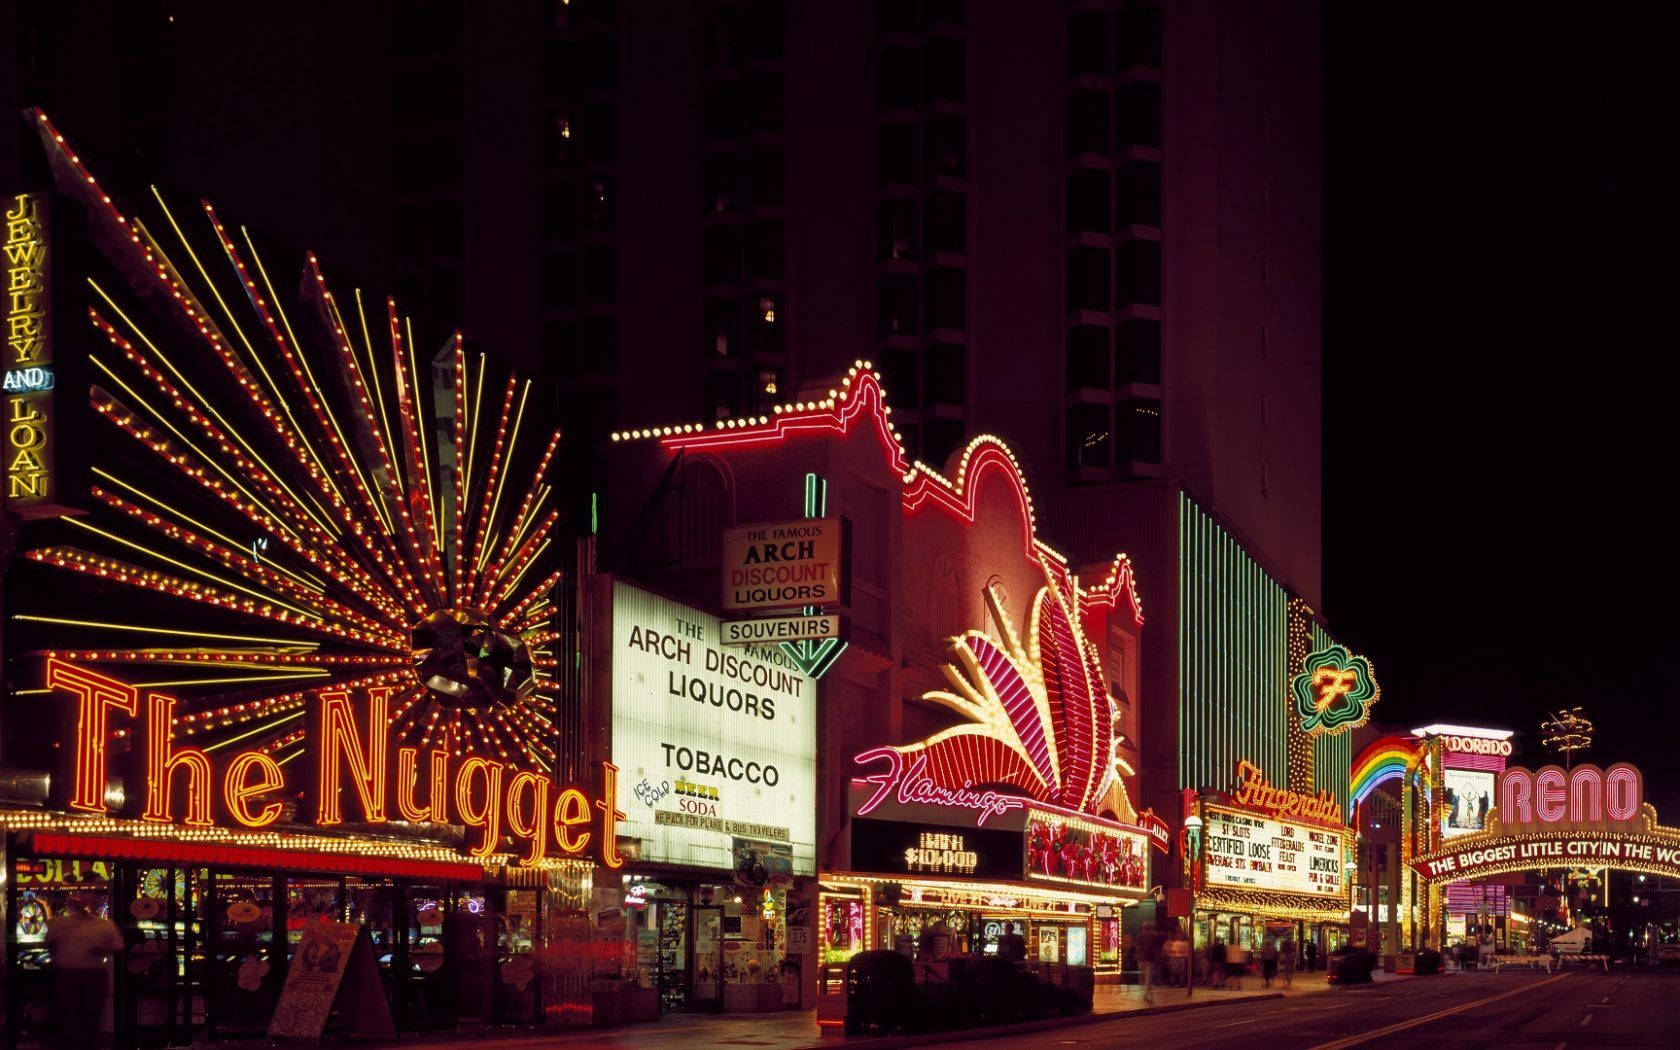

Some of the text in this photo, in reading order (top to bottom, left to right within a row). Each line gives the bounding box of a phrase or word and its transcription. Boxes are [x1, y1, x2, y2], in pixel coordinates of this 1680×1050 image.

[4, 195, 45, 363] JEWELRY
[3, 368, 52, 390] AND
[8, 398, 48, 499] LOAN
[747, 526, 823, 543] THE FAMOUS
[743, 540, 815, 565] ARCH
[731, 562, 829, 587] DISCOUNT
[735, 584, 826, 604] LIQUORS
[675, 617, 704, 642] THE
[729, 619, 831, 640] SOUVENIRS
[628, 625, 804, 698] ARCH DISCOUNT
[669, 671, 775, 721] LIQUORS
[46, 658, 627, 869] The Nugget
[661, 742, 779, 787] TOBACCO
[633, 778, 651, 800] ICE
[644, 780, 670, 808] COLD
[674, 780, 720, 801] BEER
[852, 745, 1023, 827] Flamingo
[1502, 767, 1638, 823] RENO
[679, 798, 717, 817] SODA
[666, 812, 683, 825] PACK
[685, 815, 698, 827] FOR
[700, 817, 722, 831] PLANE
[732, 821, 746, 834] BUS
[749, 823, 785, 838] TRAVELERS
[1232, 825, 1251, 838] SLOTS
[1281, 826, 1294, 837] LORD
[1208, 835, 1271, 859] CERTIFIED LOOSE
[1279, 851, 1295, 863] FEAST
[1428, 858, 1456, 876] THE
[1459, 845, 1516, 868] BIGGEST
[1520, 841, 1562, 859] LITTLE
[1567, 841, 1600, 855] CITY
[1602, 841, 1620, 856] IN
[1624, 843, 1652, 860] THE
[1207, 853, 1233, 868] AVERAGE
[1310, 856, 1338, 873] LIMERICKS
[1023, 899, 1045, 910] LIVE
